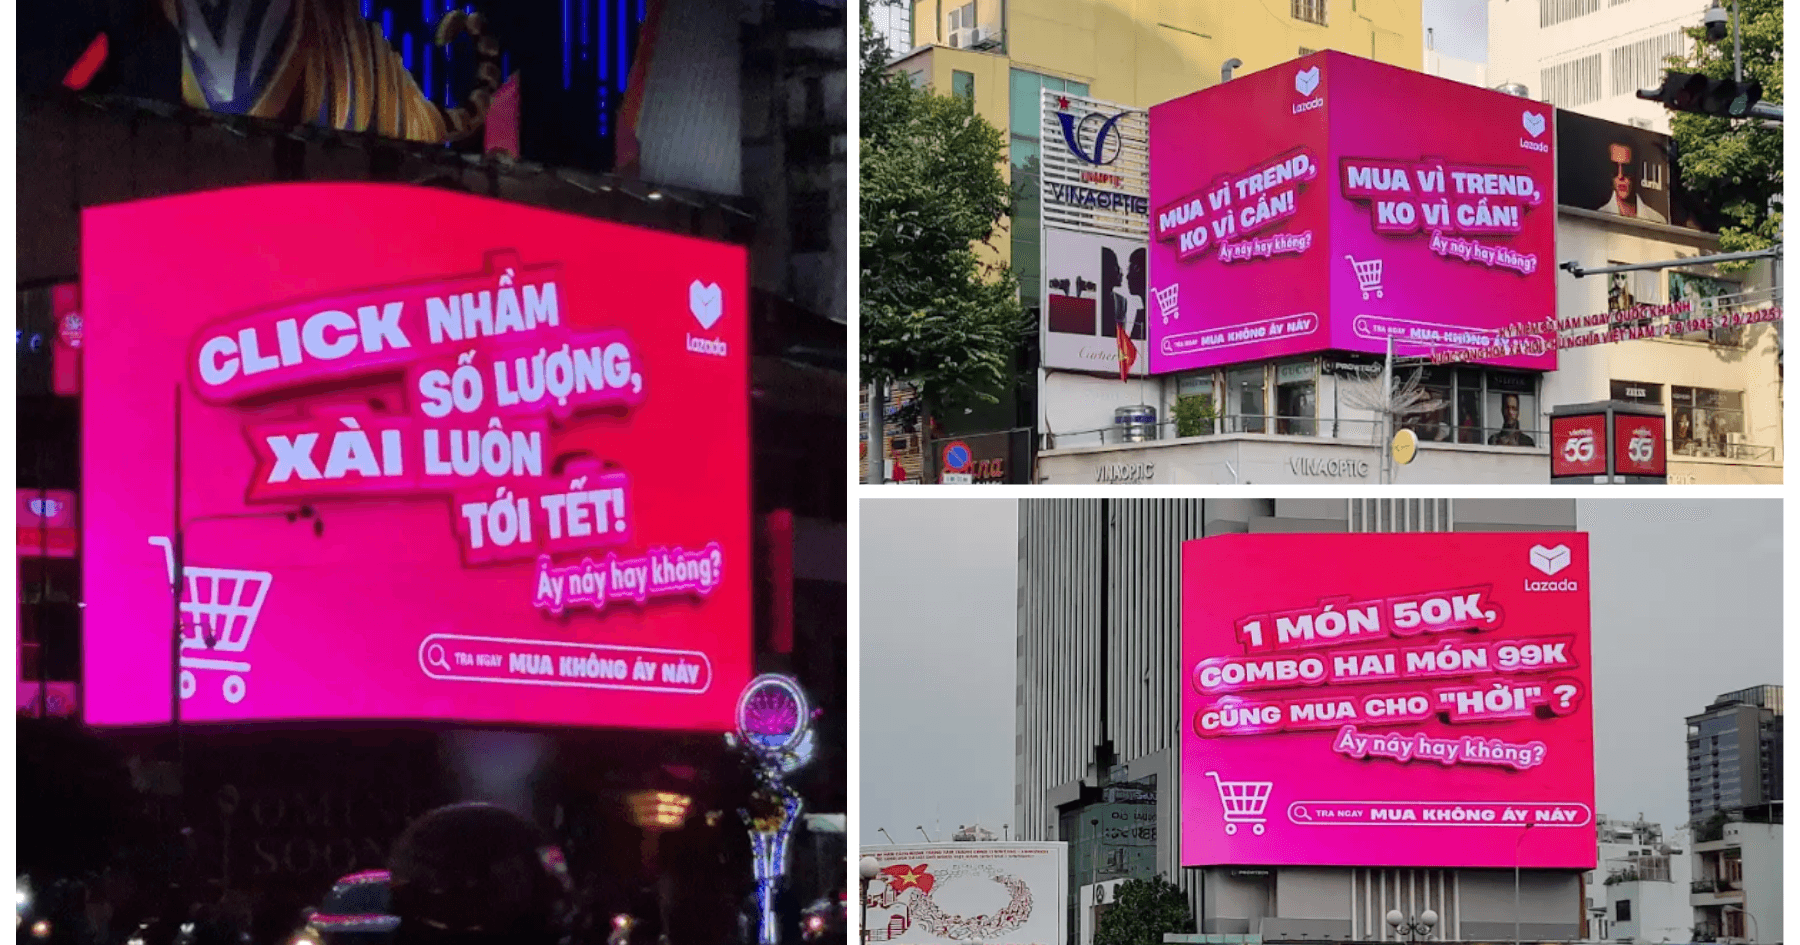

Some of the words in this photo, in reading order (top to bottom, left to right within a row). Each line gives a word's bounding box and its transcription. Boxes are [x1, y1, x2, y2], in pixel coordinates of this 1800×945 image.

[1292, 97, 1324, 115] Lazada
[1519, 137, 1549, 153] Lazada
[1050, 182, 1148, 214] VINAOPTIC
[1159, 199, 1205, 233] MUA
[1208, 181, 1232, 212] VÌ
[1235, 153, 1316, 200] TREND,
[1347, 166, 1411, 191] MUA
[1416, 165, 1446, 193] VÌ
[1451, 172, 1541, 201] TREND,
[1180, 226, 1208, 252] KO
[1212, 208, 1235, 238] VÌ
[1240, 189, 1294, 228] CẦN!
[1377, 201, 1416, 225] KO
[1421, 197, 1450, 226] VÌ
[1456, 196, 1518, 227] CẦN!
[1254, 240, 1273, 257] hay
[1474, 243, 1496, 263] hay
[198, 301, 411, 386] CLICK
[425, 268, 559, 344] NHẦM
[1200, 334, 1225, 346] MUA
[1227, 327, 1267, 342] KHÔNG
[1409, 327, 1440, 341] MUA
[686, 332, 727, 357] Lazada
[418, 349, 484, 418] SỐ
[493, 342, 642, 406] LƯỢNG,
[266, 416, 403, 483] XÀI
[423, 416, 542, 477] LUÔN
[1564, 436, 1594, 463] 5G
[1628, 436, 1654, 463] 5G
[1094, 461, 1154, 482] VINAOPTIC
[1289, 456, 1369, 478] VINAOPTIC
[461, 486, 532, 549] TỚI
[539, 475, 627, 540] TẾT!
[569, 565, 606, 600] náy
[610, 558, 648, 594] hay
[651, 549, 722, 587] không?
[1524, 578, 1578, 592] Lazada
[1243, 620, 1263, 646] 1
[1276, 604, 1380, 643] MÓN
[1393, 593, 1497, 627] 50K,
[453, 652, 474, 667] TRA
[475, 654, 503, 668] NGAY
[508, 652, 555, 676] MUA
[558, 652, 629, 681] KHÔNG
[632, 656, 657, 682] ÁY
[661, 657, 700, 685] NÁY
[1199, 657, 1324, 688] COMBO
[1334, 653, 1396, 677] HAI
[1406, 644, 1488, 672] MÓN
[1497, 642, 1568, 667] 99K
[1201, 695, 1282, 731] CŨNG
[1289, 701, 1357, 722] MUA
[1364, 696, 1429, 717] CHO
[1439, 683, 1542, 717] "HỜI"
[1553, 684, 1577, 708] ?
[1339, 729, 1368, 753] Áy
[1373, 735, 1414, 757] náy
[1419, 737, 1460, 760] hay
[1465, 740, 1545, 765] không?
[1315, 809, 1335, 818] TRA
[1337, 809, 1364, 818] NGAY
[1370, 808, 1417, 821] MUA
[1422, 805, 1497, 822] KHÔNG
[1501, 806, 1529, 821] ÁY
[1534, 807, 1578, 822] NÁY
